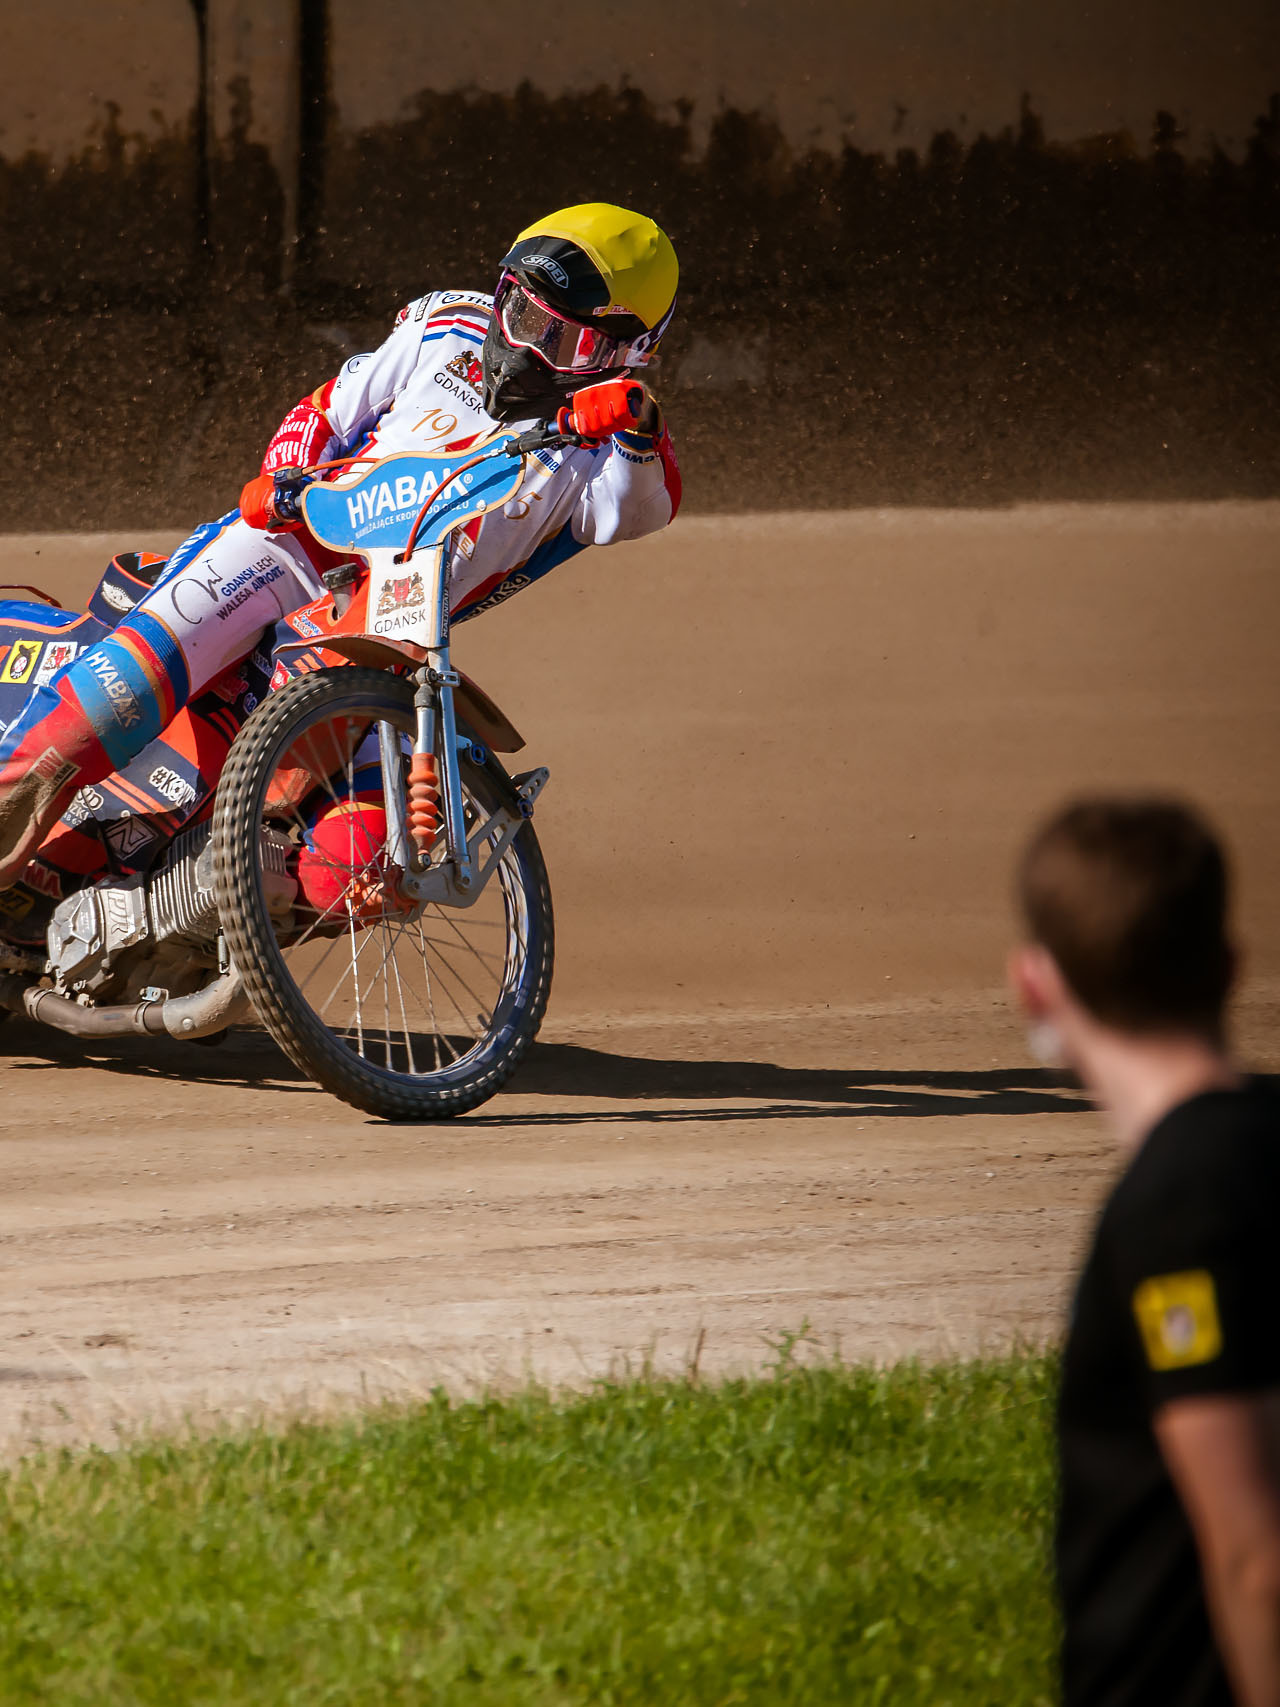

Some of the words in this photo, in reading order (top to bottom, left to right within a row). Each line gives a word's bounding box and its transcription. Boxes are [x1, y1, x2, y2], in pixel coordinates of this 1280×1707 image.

[527, 256, 566, 284] SHOEI
[411, 408, 458, 441] 19
[221, 565, 259, 597] GDANSK
[253, 554, 276, 574] LECH
[216, 587, 254, 621] WALESA
[85, 650, 142, 729] HYABAK
